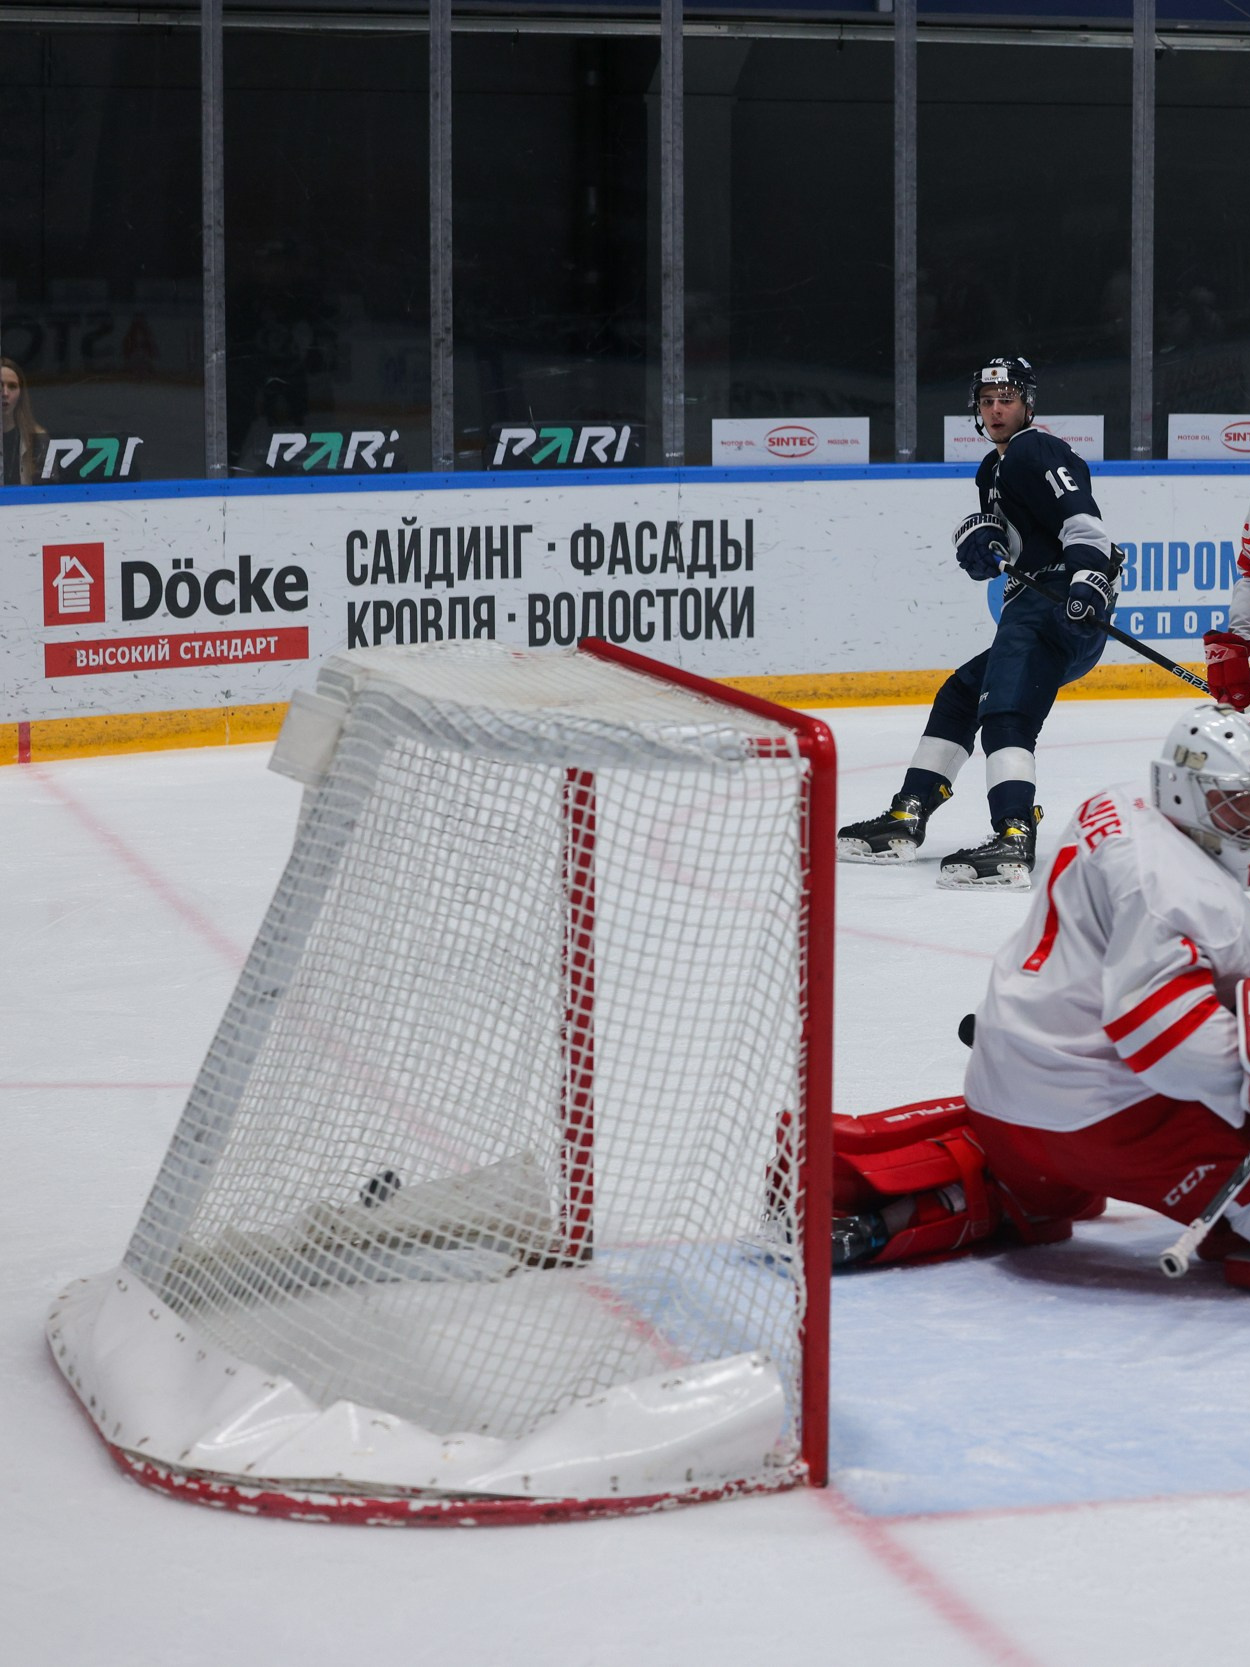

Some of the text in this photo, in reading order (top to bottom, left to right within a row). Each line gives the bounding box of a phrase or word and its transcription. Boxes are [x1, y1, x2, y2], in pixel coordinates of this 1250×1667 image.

[493, 425, 632, 466] PARI
[768, 436, 815, 447] SINTEC
[1044, 466, 1080, 499] 16
[346, 516, 754, 590] САЙДИНГ ФАСАДЫ
[120, 554, 309, 622] Döcke
[527, 586, 755, 648] ВОДОСТОКИ
[75, 635, 279, 667] ВЫСОКИЙ СТАНДАРТ
